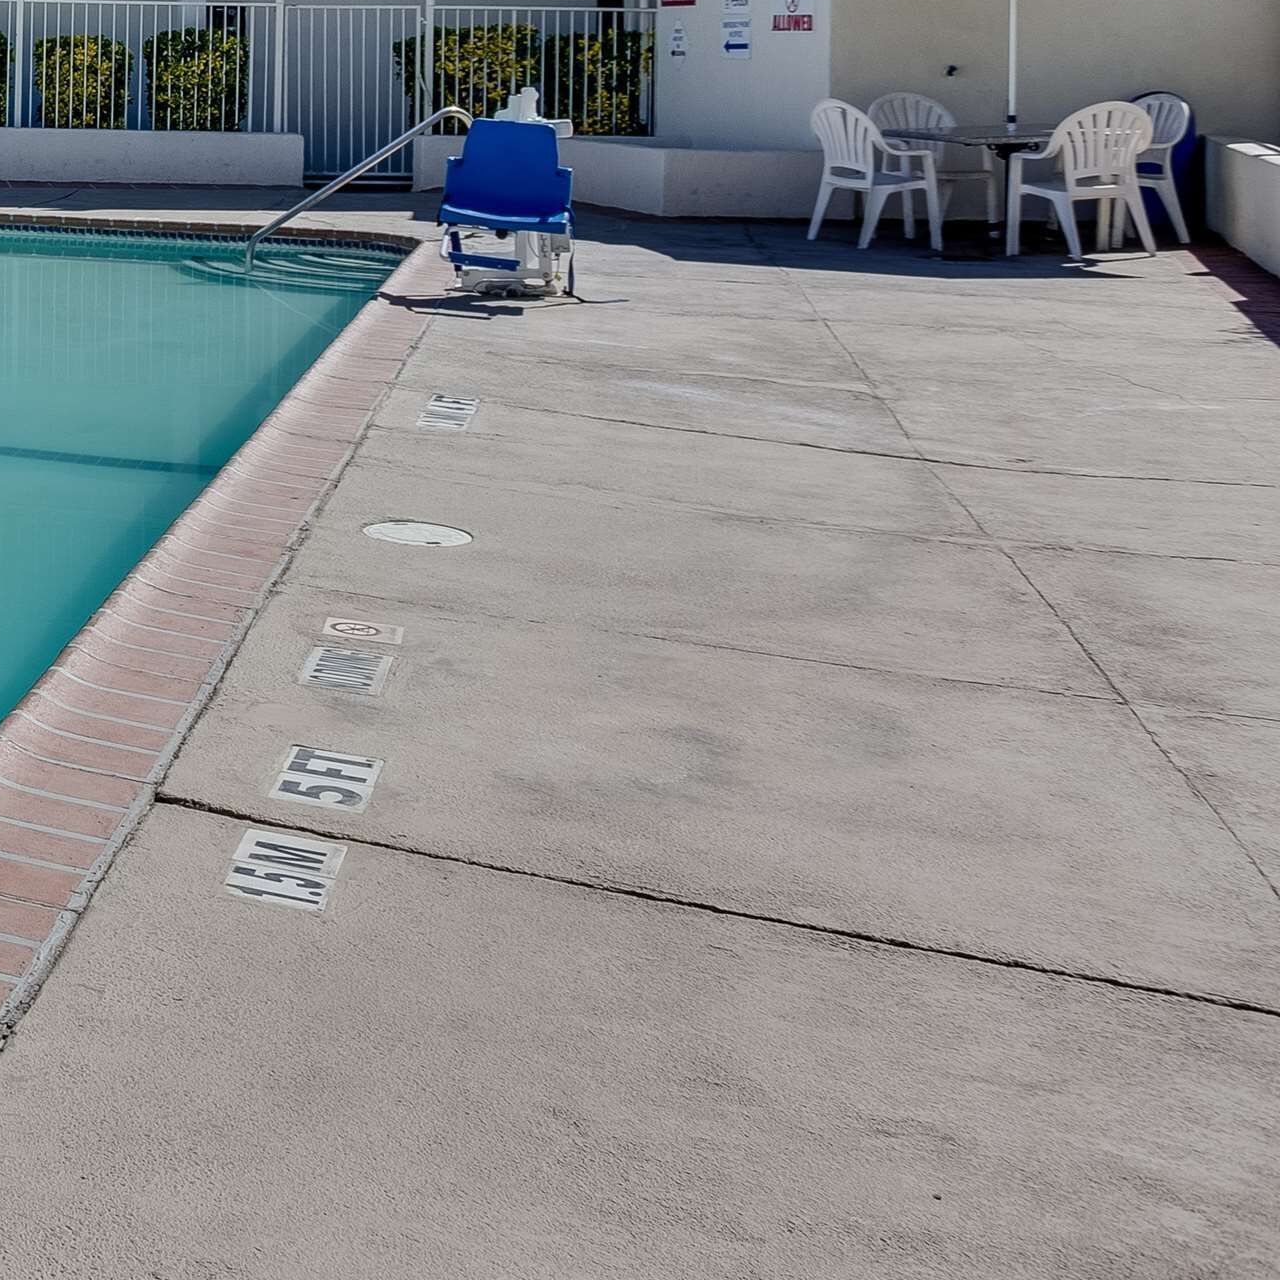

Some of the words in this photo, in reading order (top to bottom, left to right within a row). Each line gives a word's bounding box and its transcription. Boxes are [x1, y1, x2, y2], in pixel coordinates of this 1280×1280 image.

[771, 15, 813, 31] ALLOWED
[278, 780, 363, 807] 5
[225, 840, 327, 905] 1.5M
